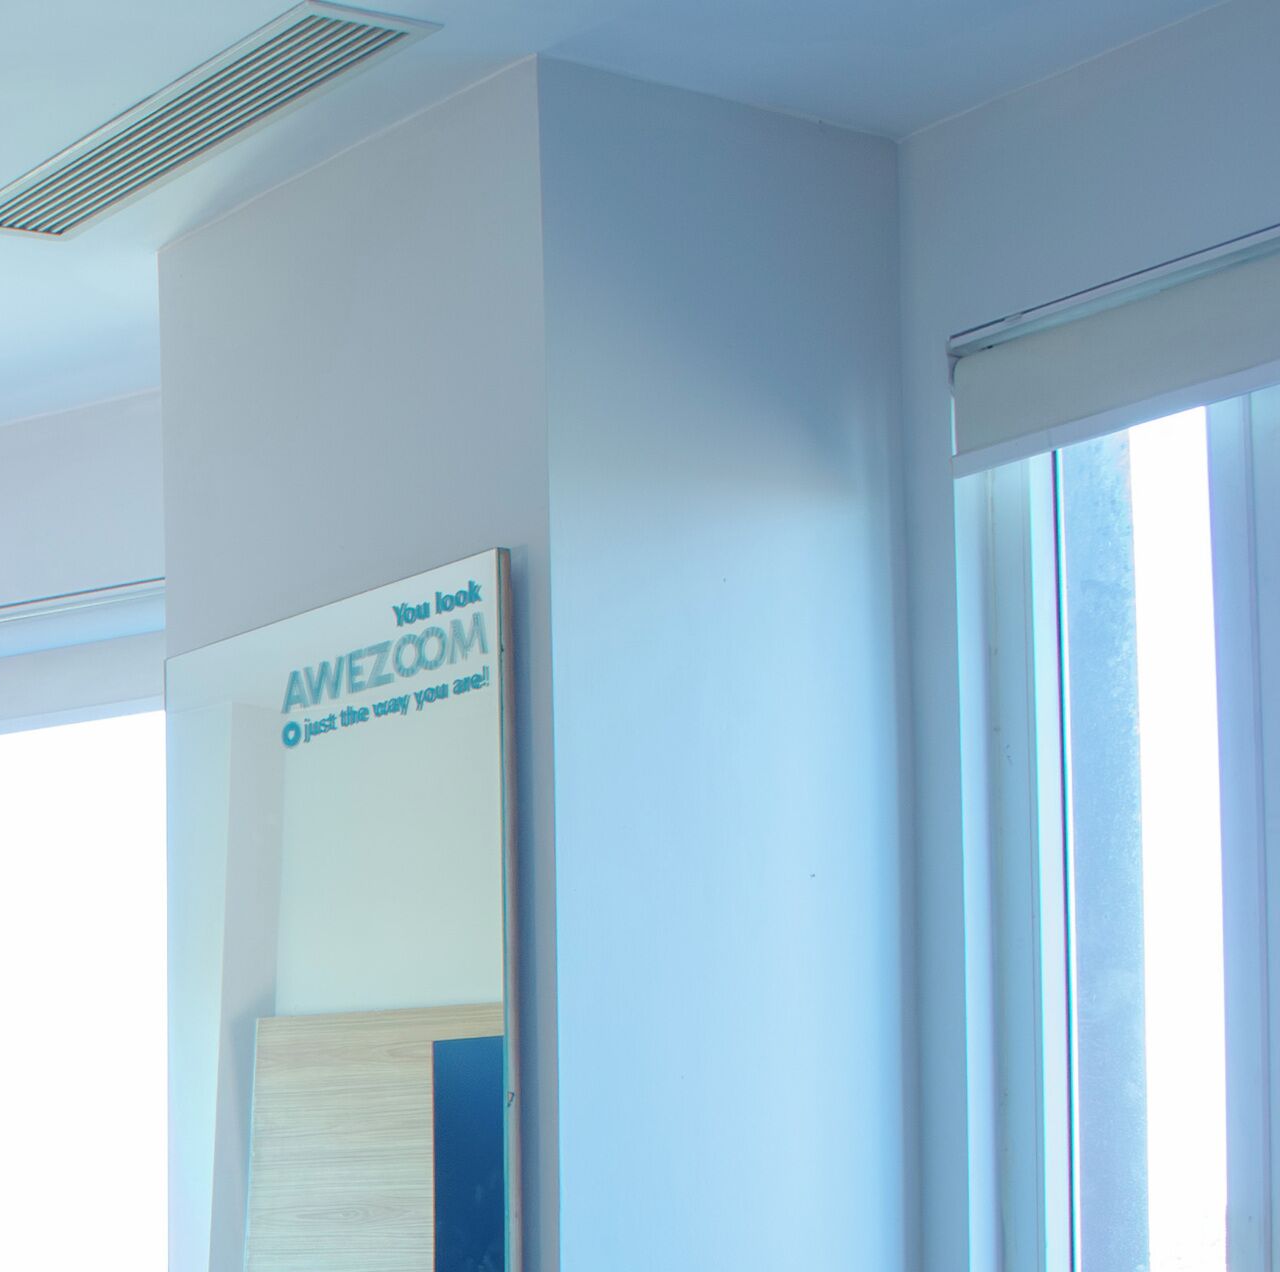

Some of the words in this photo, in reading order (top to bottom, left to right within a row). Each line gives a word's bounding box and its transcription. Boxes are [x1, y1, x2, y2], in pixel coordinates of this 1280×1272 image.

[392, 602, 430, 627] You
[435, 579, 482, 615] look
[281, 611, 489, 714] AWEZOOM
[303, 713, 338, 743] just
[340, 705, 370, 728] the
[372, 694, 411, 716] way
[414, 682, 449, 712] you
